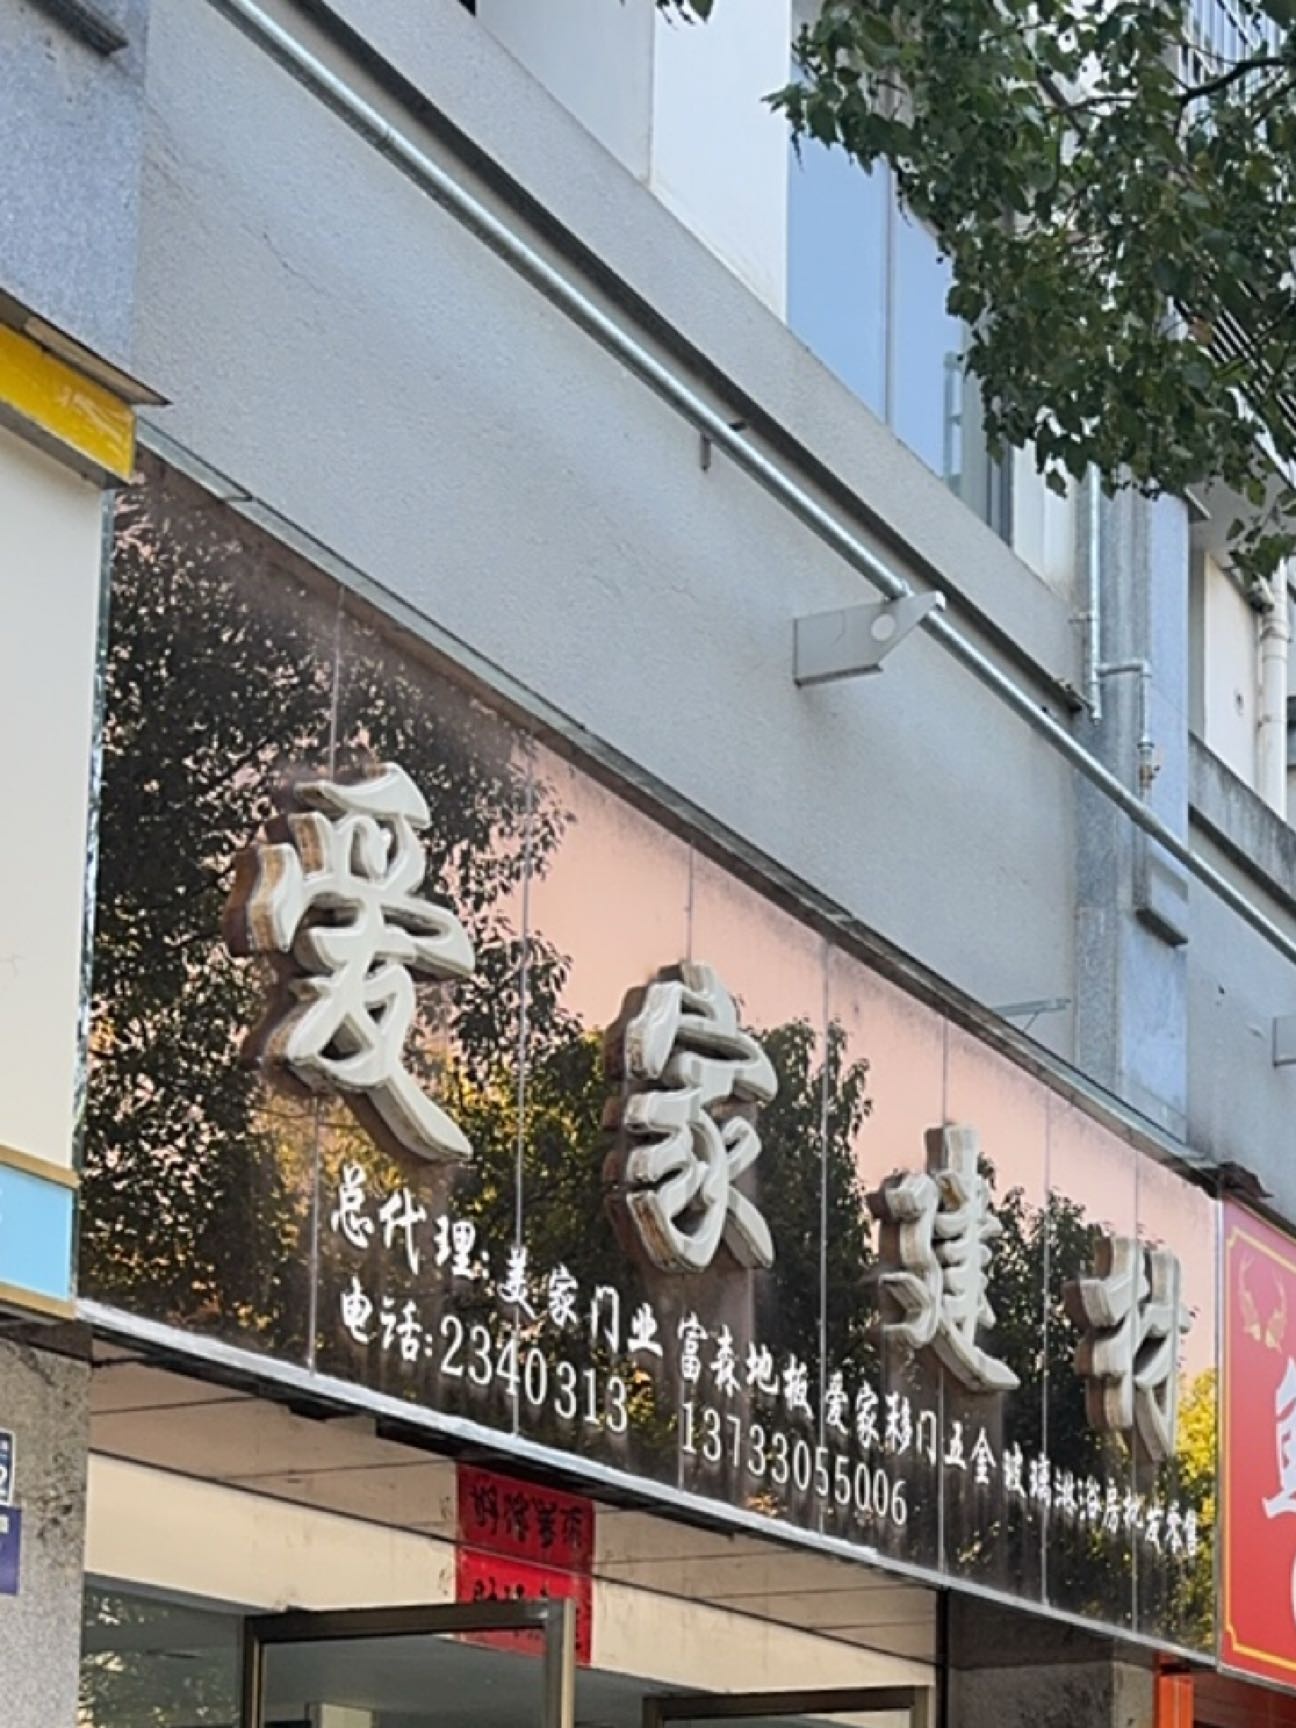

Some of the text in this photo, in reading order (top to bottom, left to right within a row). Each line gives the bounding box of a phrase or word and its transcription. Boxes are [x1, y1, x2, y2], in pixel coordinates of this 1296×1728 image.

[226, 762, 1192, 1463] 爱家建材
[681, 1402, 908, 1526] 13733055006
